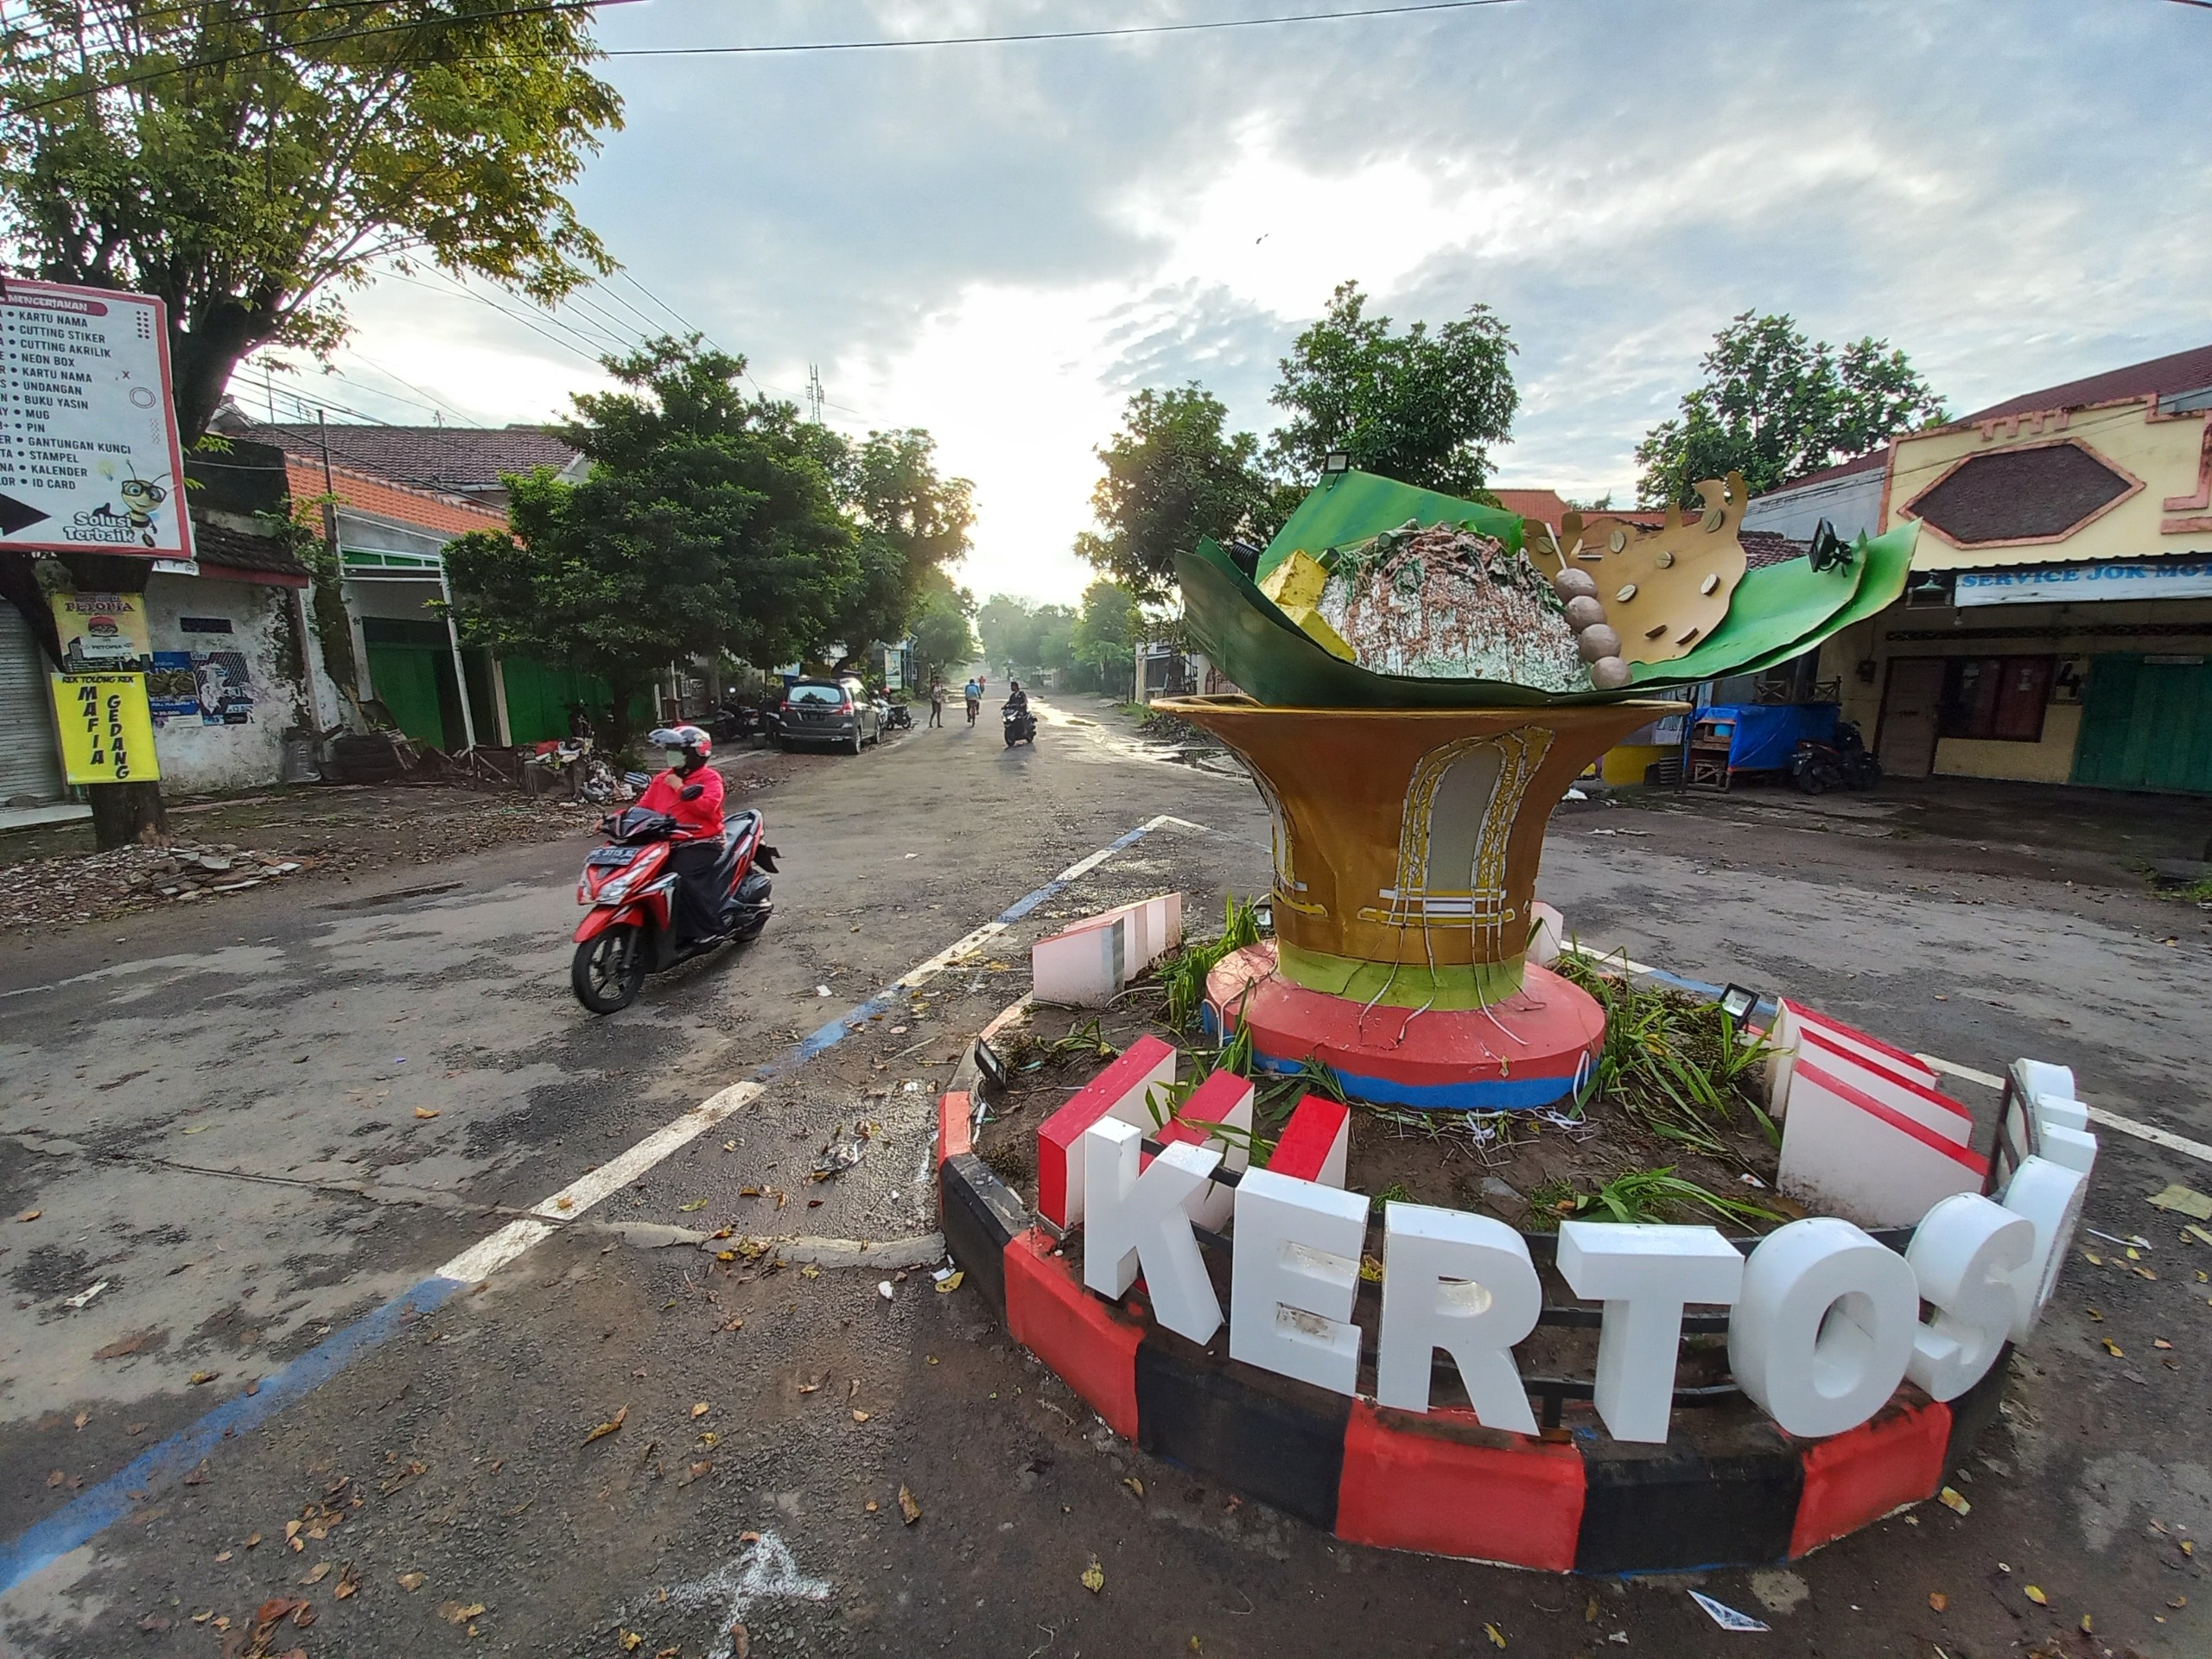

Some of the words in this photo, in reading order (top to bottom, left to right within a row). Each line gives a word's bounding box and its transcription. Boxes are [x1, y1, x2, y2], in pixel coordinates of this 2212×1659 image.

[19, 311, 53, 324] KARTU
[57, 315, 88, 327] NAMA
[20, 325, 65, 339] CUTTING
[68, 330, 105, 344] STIKER
[20, 340, 66, 353] CUTTING
[69, 345, 111, 359] AKRILIK
[22, 353, 50, 365] NEON
[54, 357, 75, 367] BOX
[22, 367, 57, 379] KARTU
[61, 372, 92, 383] NAMA
[23, 381, 82, 396] UNDANGAN
[25, 395, 53, 406] BUKU
[57, 398, 89, 410] YASIN
[26, 409, 50, 420] MUG
[27, 423, 45, 433] PIN
[29, 436, 93, 451] GANTUNGAN
[98, 443, 131, 454] KUNCI
[29, 451, 79, 463] STAMPEL
[31, 465, 87, 477] KALENDER
[33, 479, 43, 487] ID
[47, 480, 76, 490] CARD
[74, 511, 133, 527] Solusi
[63, 526, 135, 543] Terbaik
[1961, 568, 2079, 588] SERVICE
[2086, 565, 2147, 581] JOK
[77, 685, 105, 765] MAFIA
[107, 694, 130, 779] GEDANG
